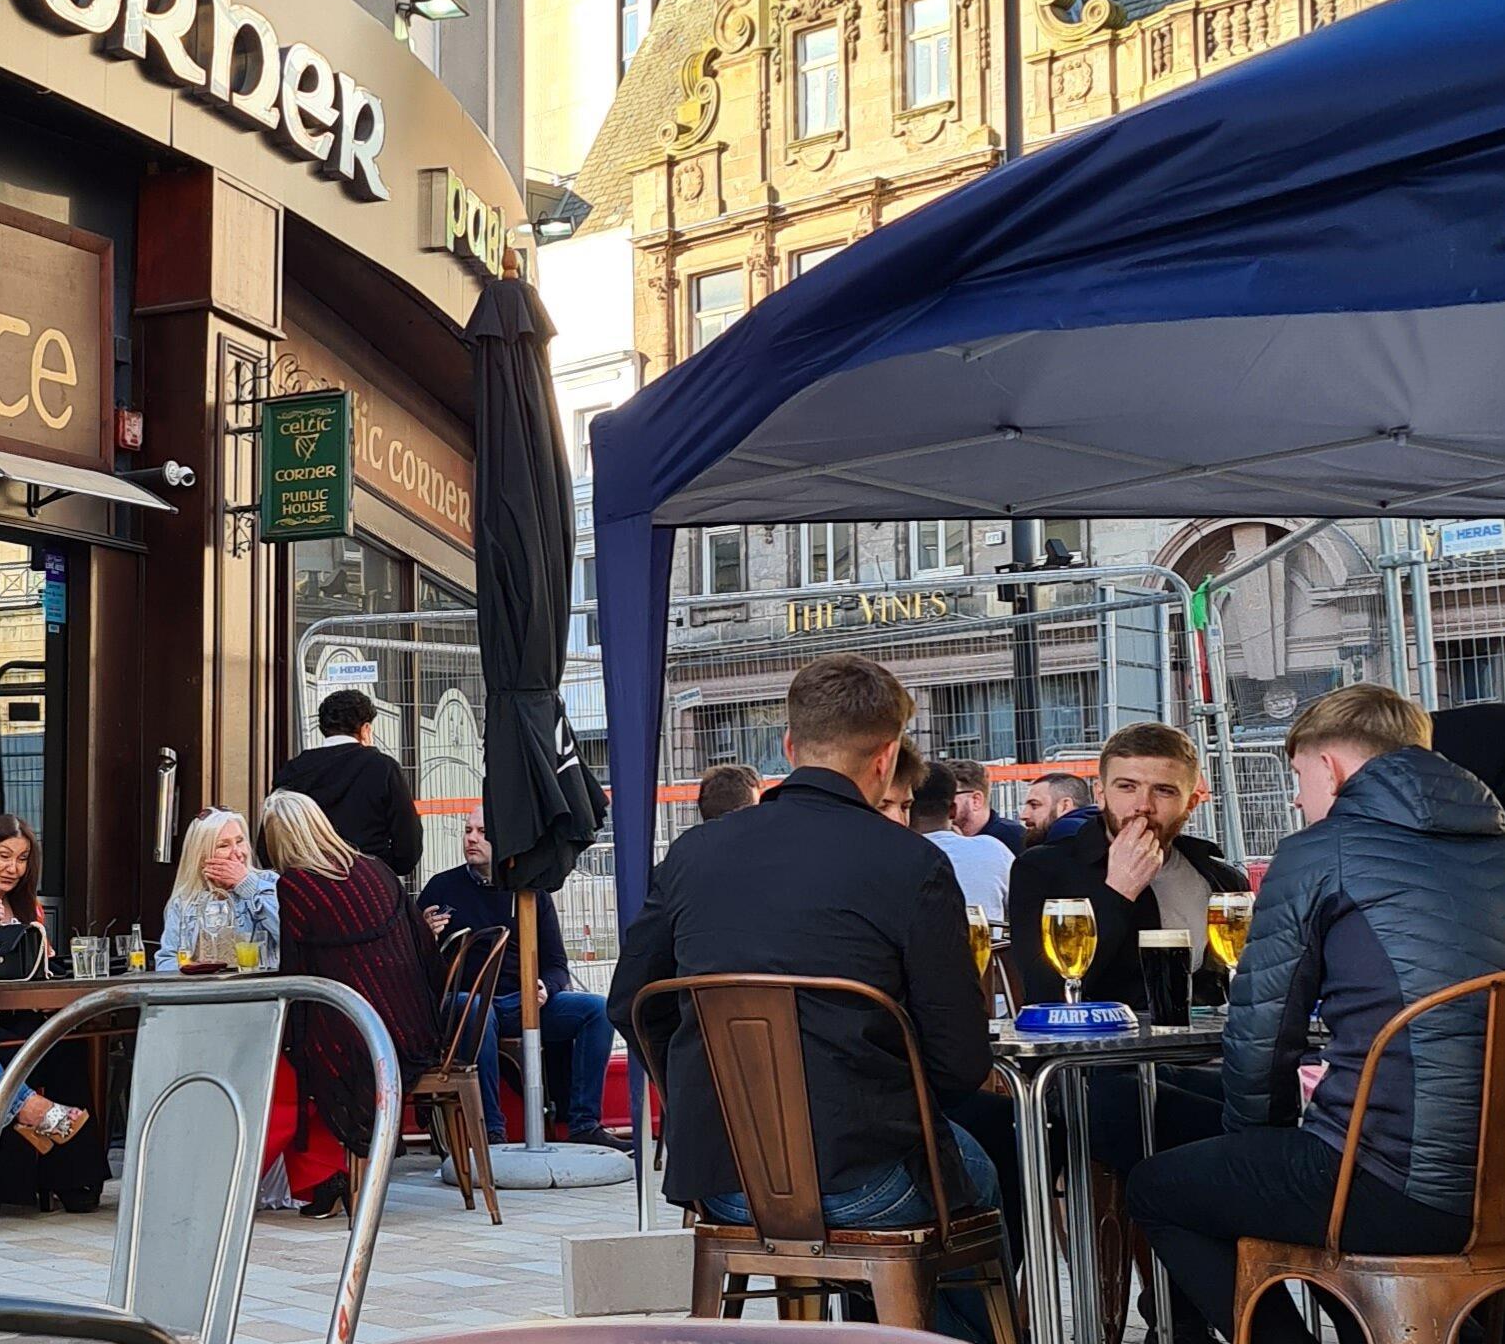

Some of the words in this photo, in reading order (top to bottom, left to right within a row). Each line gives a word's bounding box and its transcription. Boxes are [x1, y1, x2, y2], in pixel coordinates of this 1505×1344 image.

[281, 488, 330, 504] PUBLIC
[282, 500, 327, 516] HOUSE
[1456, 523, 1503, 540] HERAS
[784, 600, 841, 633] THE
[858, 589, 948, 624] VINES
[339, 664, 376, 674] HERAS
[1048, 1009, 1089, 1024] HARP
